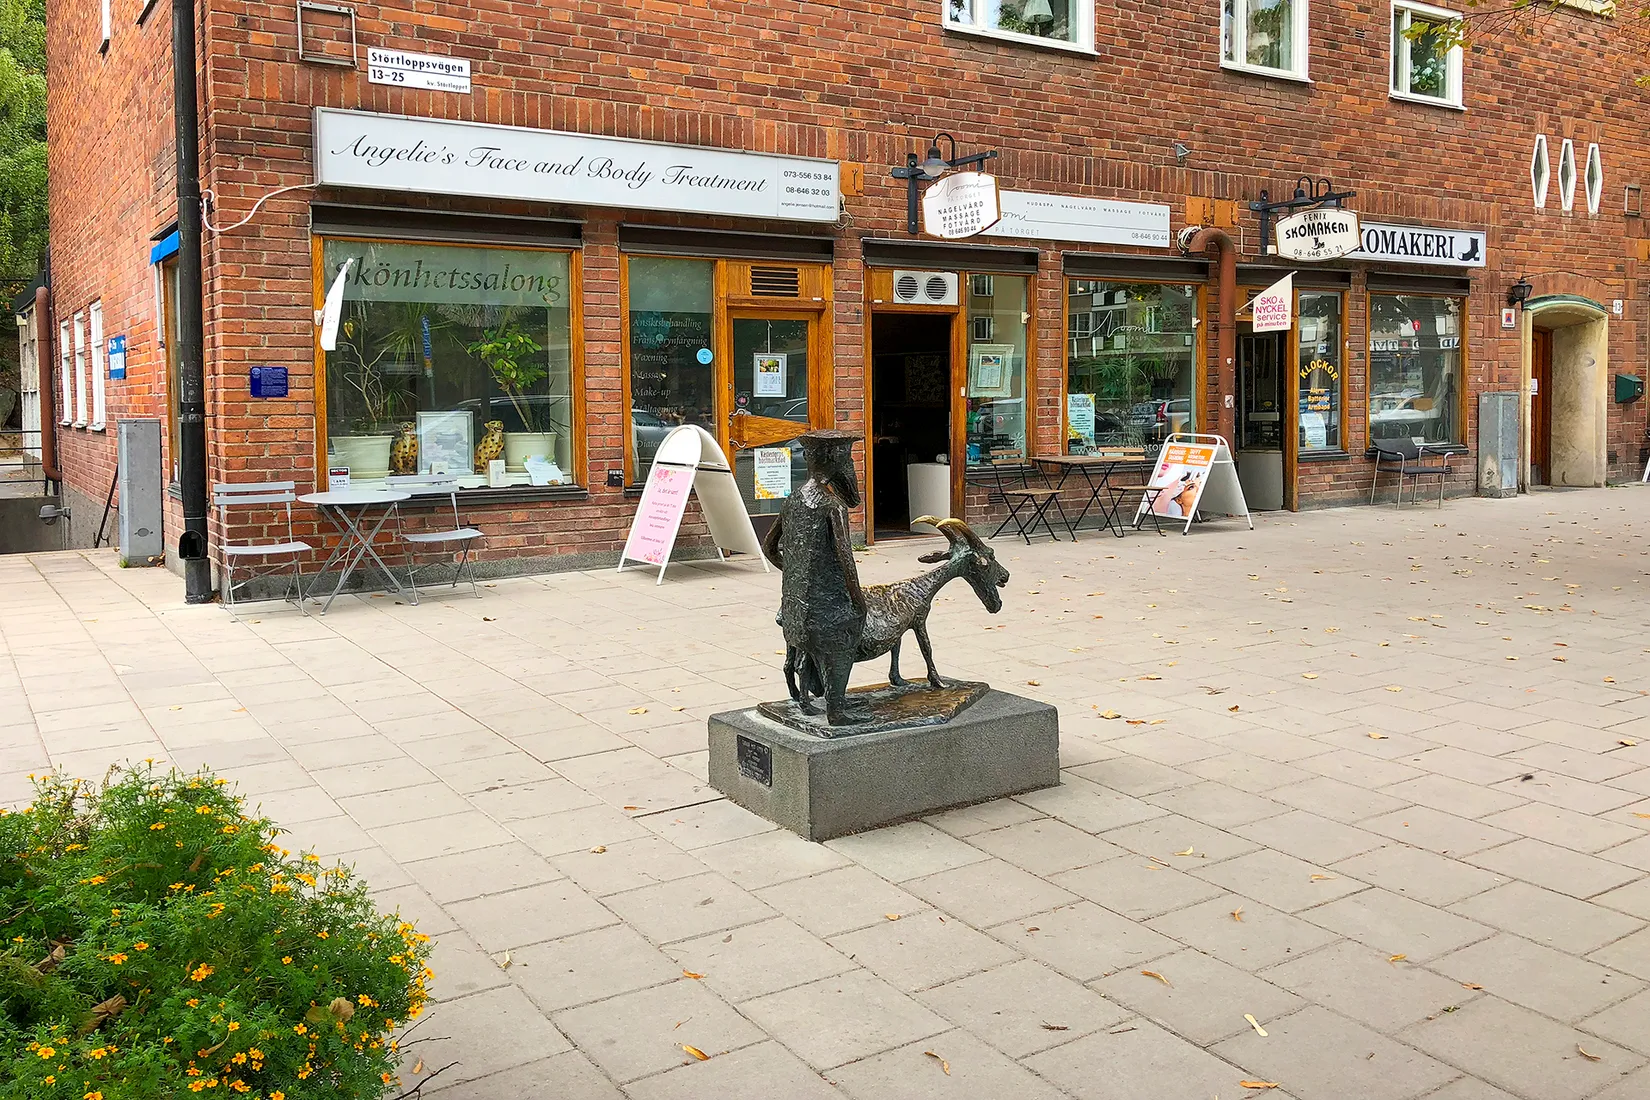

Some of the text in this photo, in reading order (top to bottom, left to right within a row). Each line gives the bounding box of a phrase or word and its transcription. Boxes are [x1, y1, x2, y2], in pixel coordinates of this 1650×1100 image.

[372, 52, 463, 73] Störtloppsvägen
[372, 69, 404, 82] 13-25
[331, 135, 768, 193] Angelie's Face and Body Treatment
[783, 170, 812, 179] 073-556
[785, 186, 810, 195] 08-646
[938, 201, 984, 215] NAGELVÅRD
[942, 209, 981, 221] MASSAGE
[1303, 212, 1327, 222] FENIX
[943, 217, 982, 229] FOTVÅRD
[995, 226, 1040, 236] PÅ TORGET
[1285, 221, 1349, 239] SKOMAKERI
[1131, 232, 1151, 240] 08-646
[1152, 233, 1161, 241] 90
[1354, 228, 1455, 259] OMAKERI
[1323, 248, 1333, 256] 55
[1260, 296, 1278, 305] SKO
[1255, 304, 1289, 314] NYCKEL
[1256, 313, 1287, 321] service
[632, 317, 702, 331] Ansiktsbehandling
[634, 353, 668, 364] Vaxning
[1299, 359, 1339, 381] KLOCKOR
[634, 387, 671, 399] Make-up
[637, 440, 660, 448] Diater
